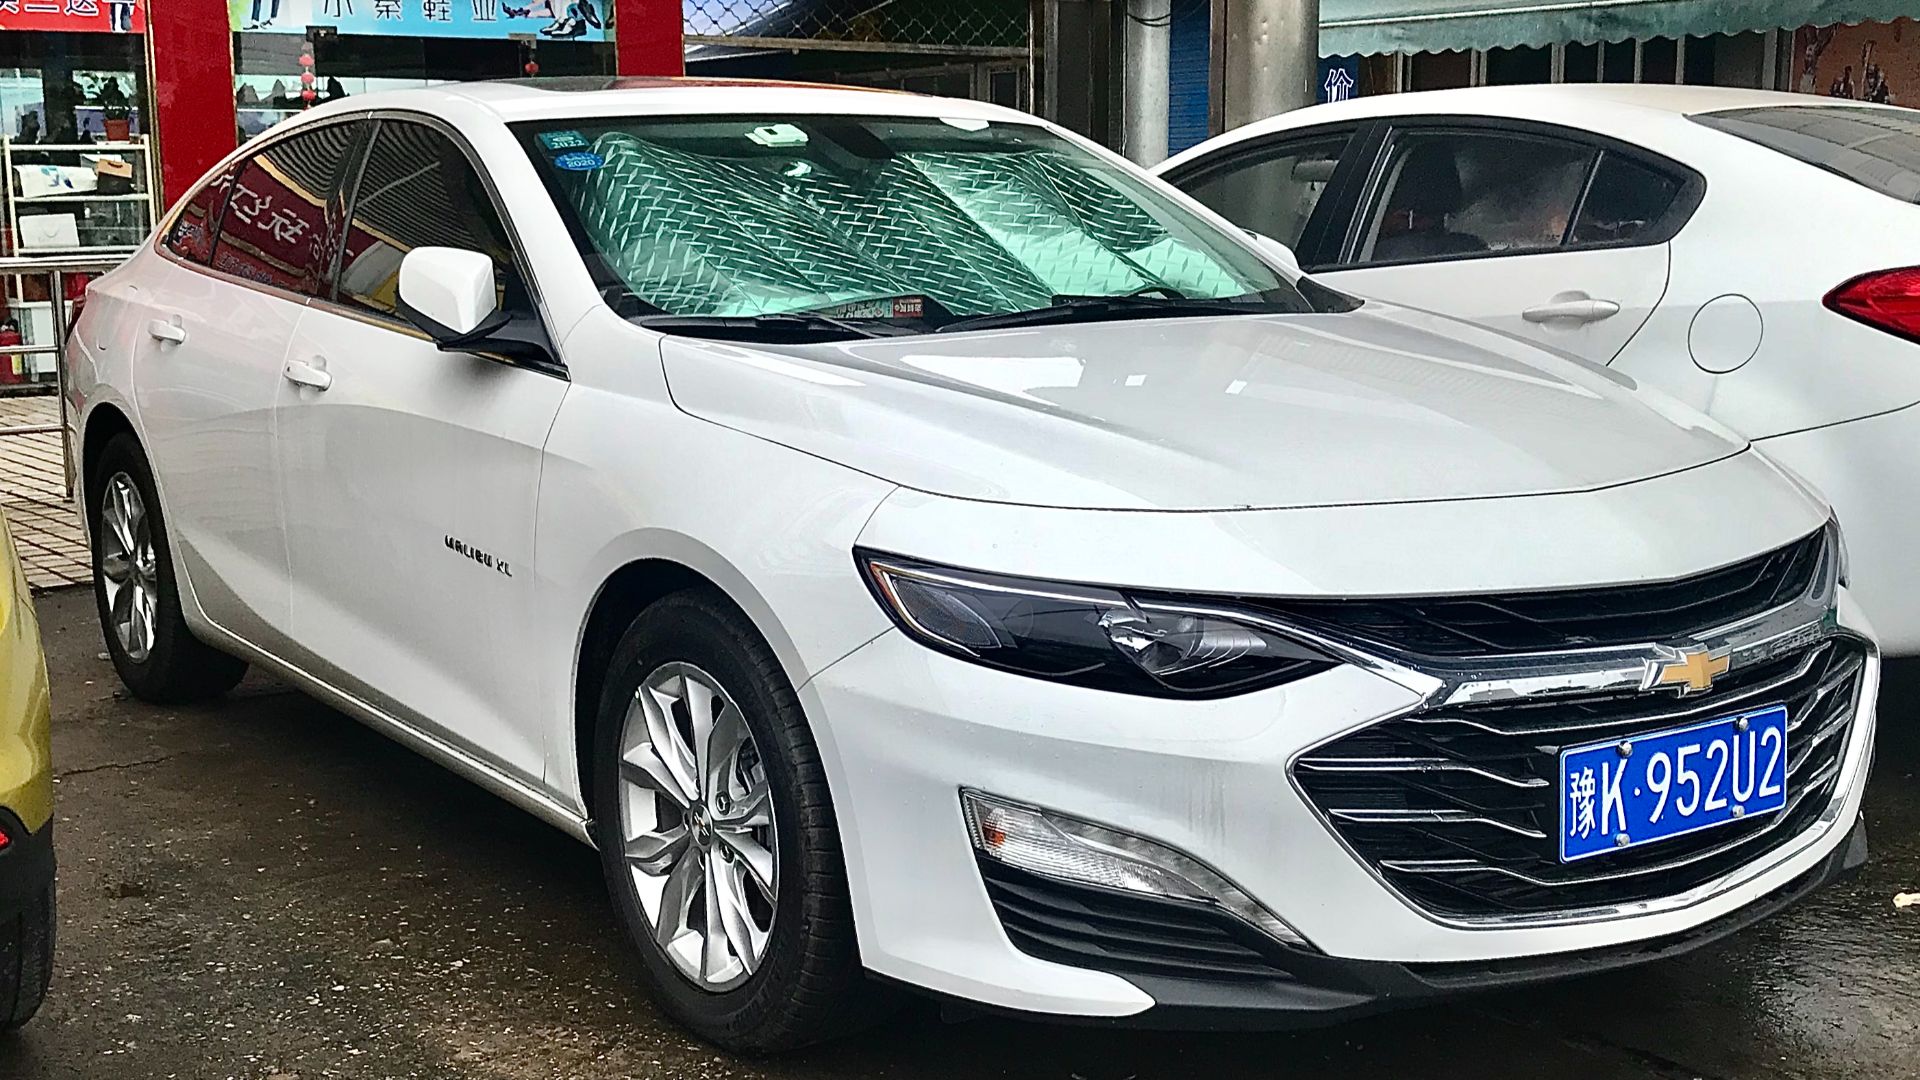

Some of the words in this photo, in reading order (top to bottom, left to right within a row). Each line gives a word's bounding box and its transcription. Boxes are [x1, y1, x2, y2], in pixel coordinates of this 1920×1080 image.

[566, 159, 596, 168] 2020
[444, 534, 493, 568] MALIBU
[496, 558, 513, 577] XL
